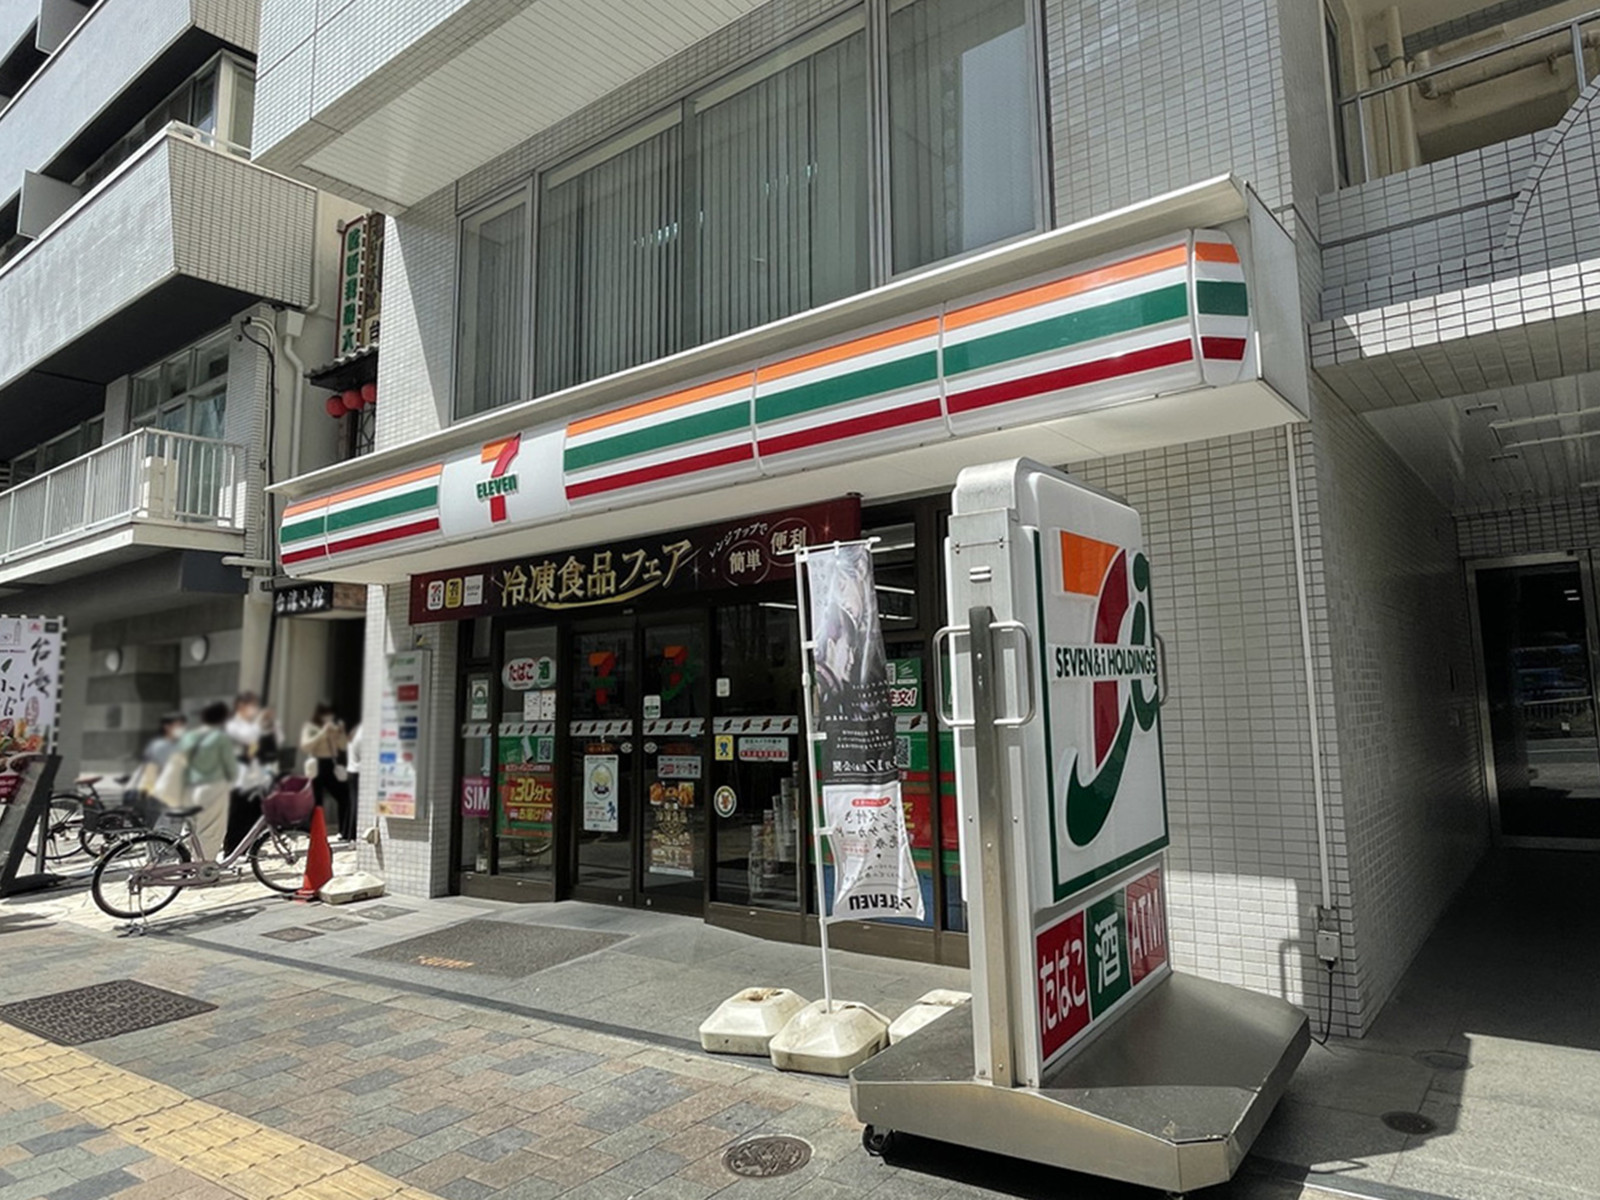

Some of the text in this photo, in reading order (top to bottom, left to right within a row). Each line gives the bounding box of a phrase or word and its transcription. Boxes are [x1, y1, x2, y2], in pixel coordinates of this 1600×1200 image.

[477, 474, 518, 499] ELEVEN
[770, 527, 807, 555] 便利
[502, 539, 692, 607] 冷凍食品フェア
[729, 549, 762, 575] 簡単
[508, 662, 535, 682] たばこ
[538, 661, 551, 680] 酒
[1107, 648, 1157, 676] HOLDINGS
[464, 785, 491, 811] SIM
[1131, 887, 1161, 965] ATM
[1094, 912, 1121, 994] 酒
[1040, 938, 1086, 1036] たばこ
